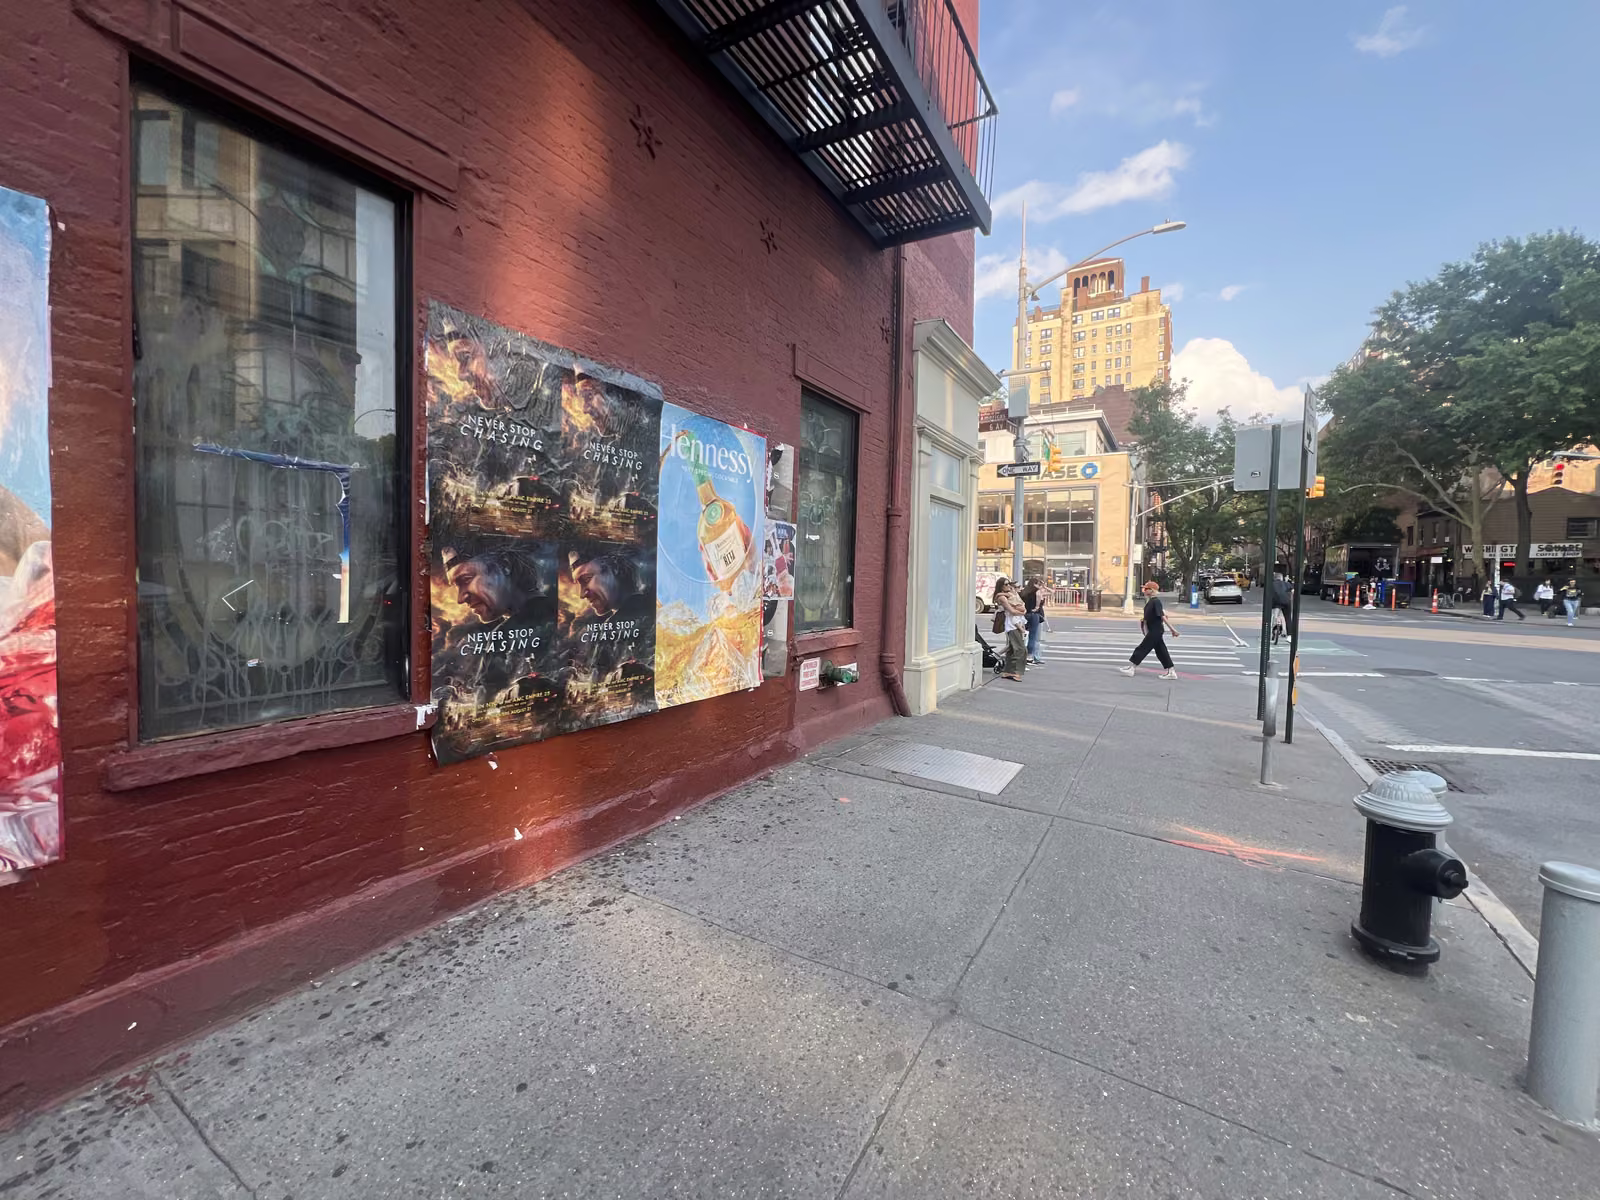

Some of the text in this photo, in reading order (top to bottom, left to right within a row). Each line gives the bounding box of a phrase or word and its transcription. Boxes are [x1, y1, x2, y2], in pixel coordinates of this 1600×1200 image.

[467, 414, 536, 438] NEVER STOP
[460, 424, 544, 451] CHASING
[588, 442, 638, 459] NEVER STOP
[583, 449, 644, 471] CHASING
[1537, 544, 1581, 552] SQUARE
[586, 620, 635, 632] NEVER STOP
[467, 628, 534, 643] NEVER STOP
[580, 629, 640, 643] CHASING
[460, 637, 541, 656] CHASING
